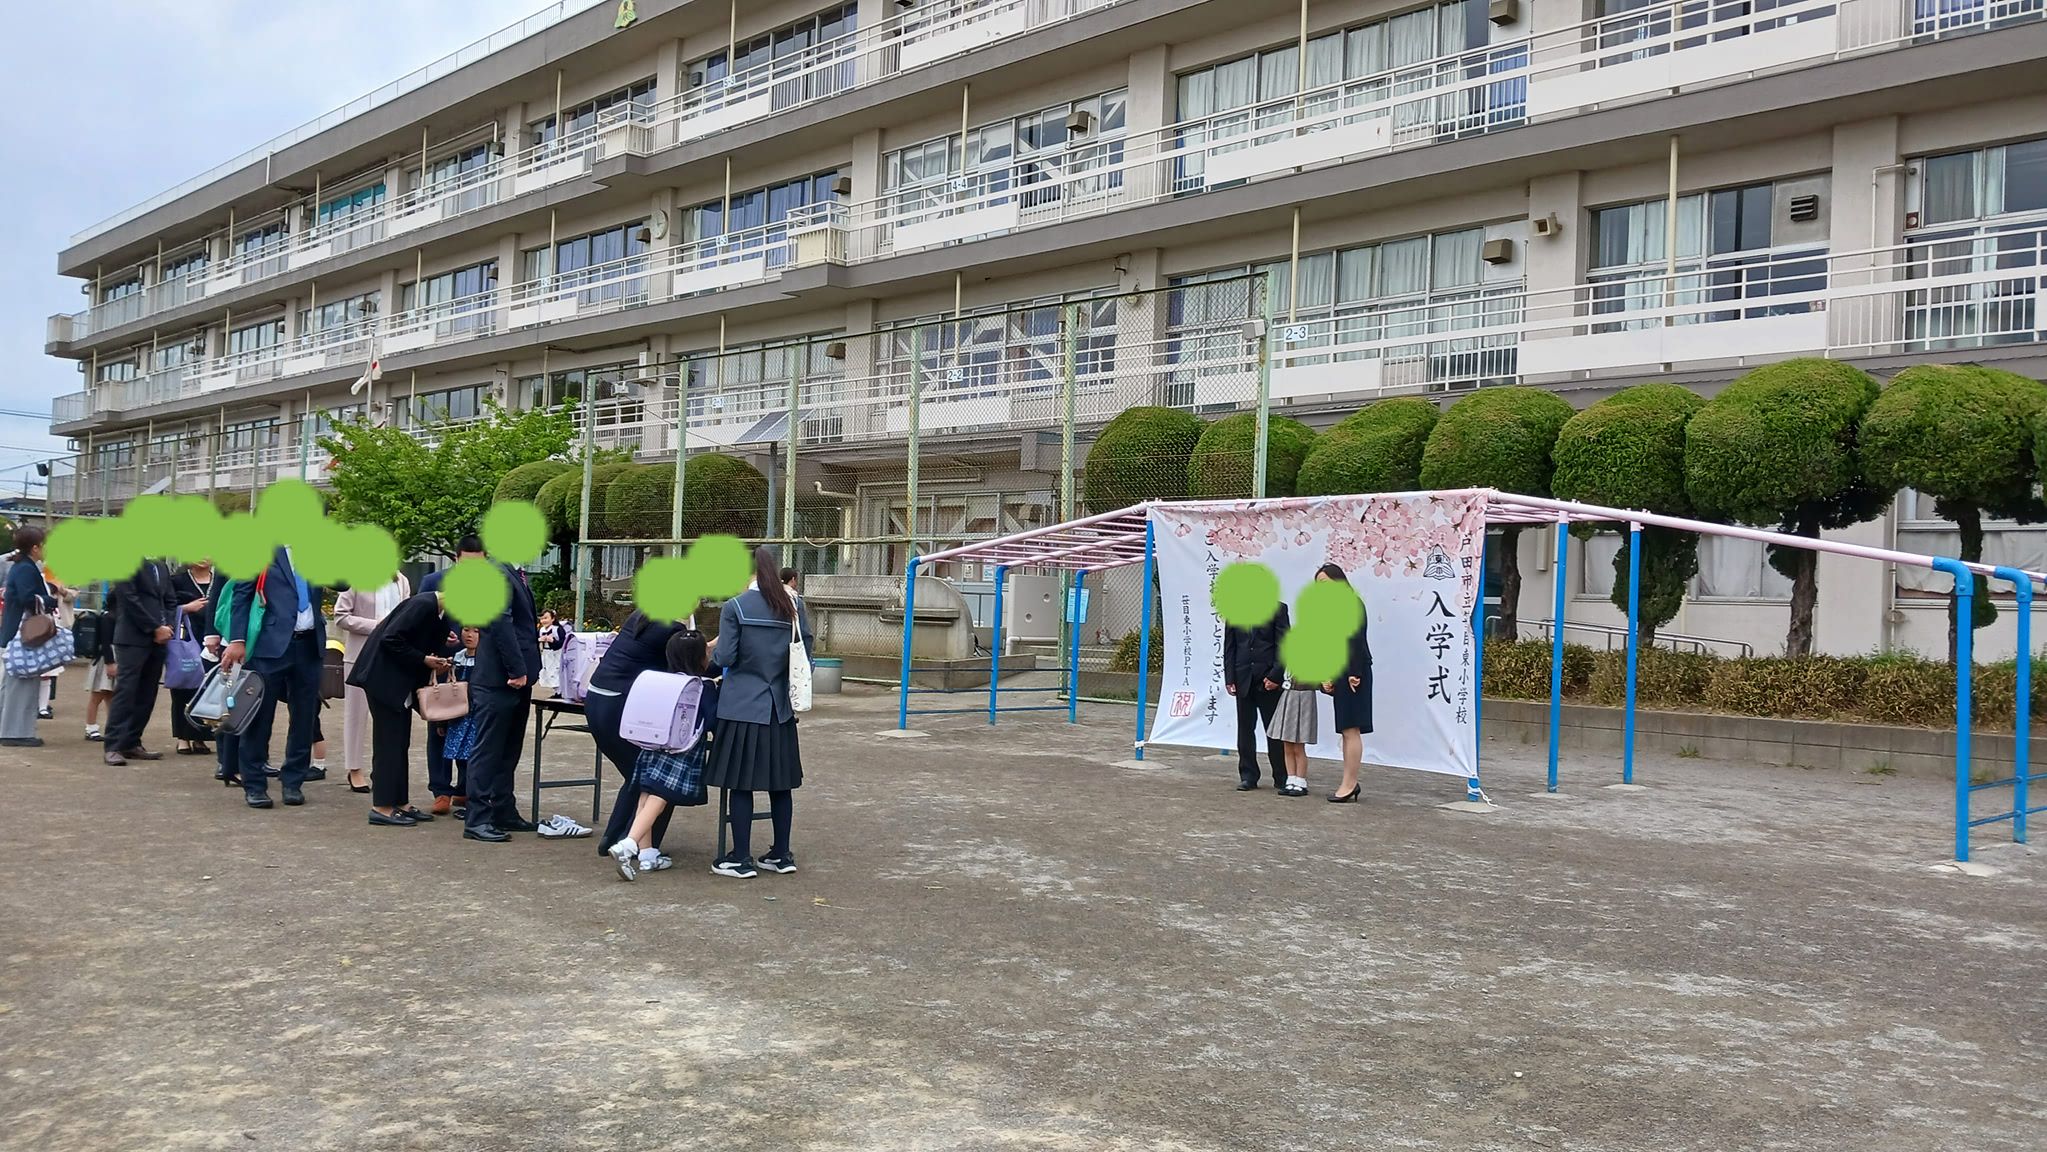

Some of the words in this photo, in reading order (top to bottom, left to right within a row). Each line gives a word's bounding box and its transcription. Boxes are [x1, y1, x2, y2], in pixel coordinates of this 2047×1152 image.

[952, 178, 967, 190] 4-4
[1285, 326, 1306, 341] 2-3
[947, 369, 962, 381] 2-2
[1425, 590, 1456, 705] 入学式
[1172, 692, 1194, 717] 祝
